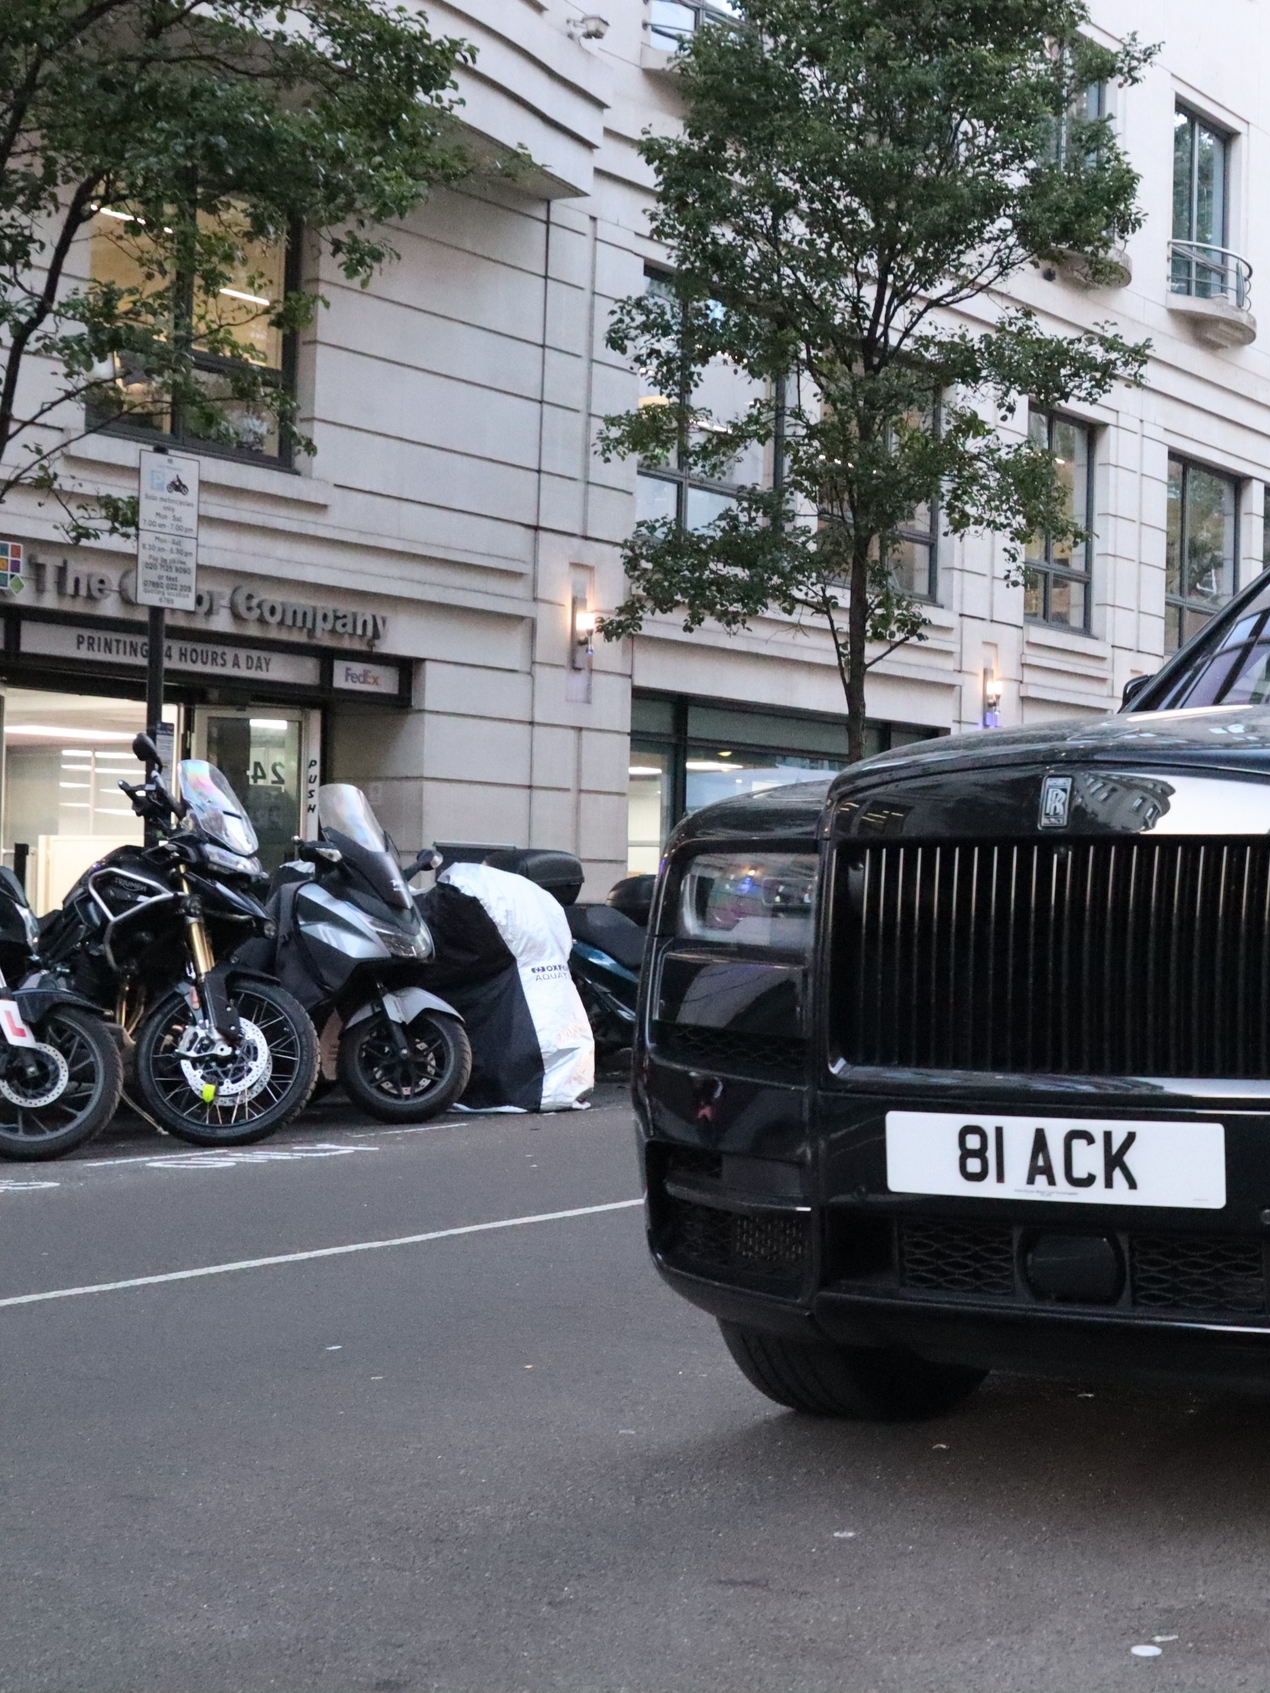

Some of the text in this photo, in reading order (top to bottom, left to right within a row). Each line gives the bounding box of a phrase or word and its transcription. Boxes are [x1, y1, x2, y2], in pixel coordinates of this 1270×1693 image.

[159, 496, 194, 508] motorcycles
[163, 505, 175, 513] only
[155, 512, 168, 520] Mon
[172, 514, 182, 523] Sat
[155, 536, 167, 544] Mon
[171, 538, 182, 546] Sat
[148, 554, 158, 562] Pay
[144, 562, 158, 570] 020
[28, 554, 113, 601] The
[230, 584, 388, 650] Company
[76, 633, 149, 659] PRINTING
[179, 650, 227, 667] HOURS
[232, 654, 241, 669] A
[246, 655, 272, 673] DAY
[344, 667, 380, 686] FedEx
[307, 760, 318, 814] PUSH
[114, 877, 147, 892] TRIUMPH
[536, 973, 569, 981] AQUAT
[4, 1010, 26, 1037] L
[958, 1125, 1138, 1190] 81 ACK
